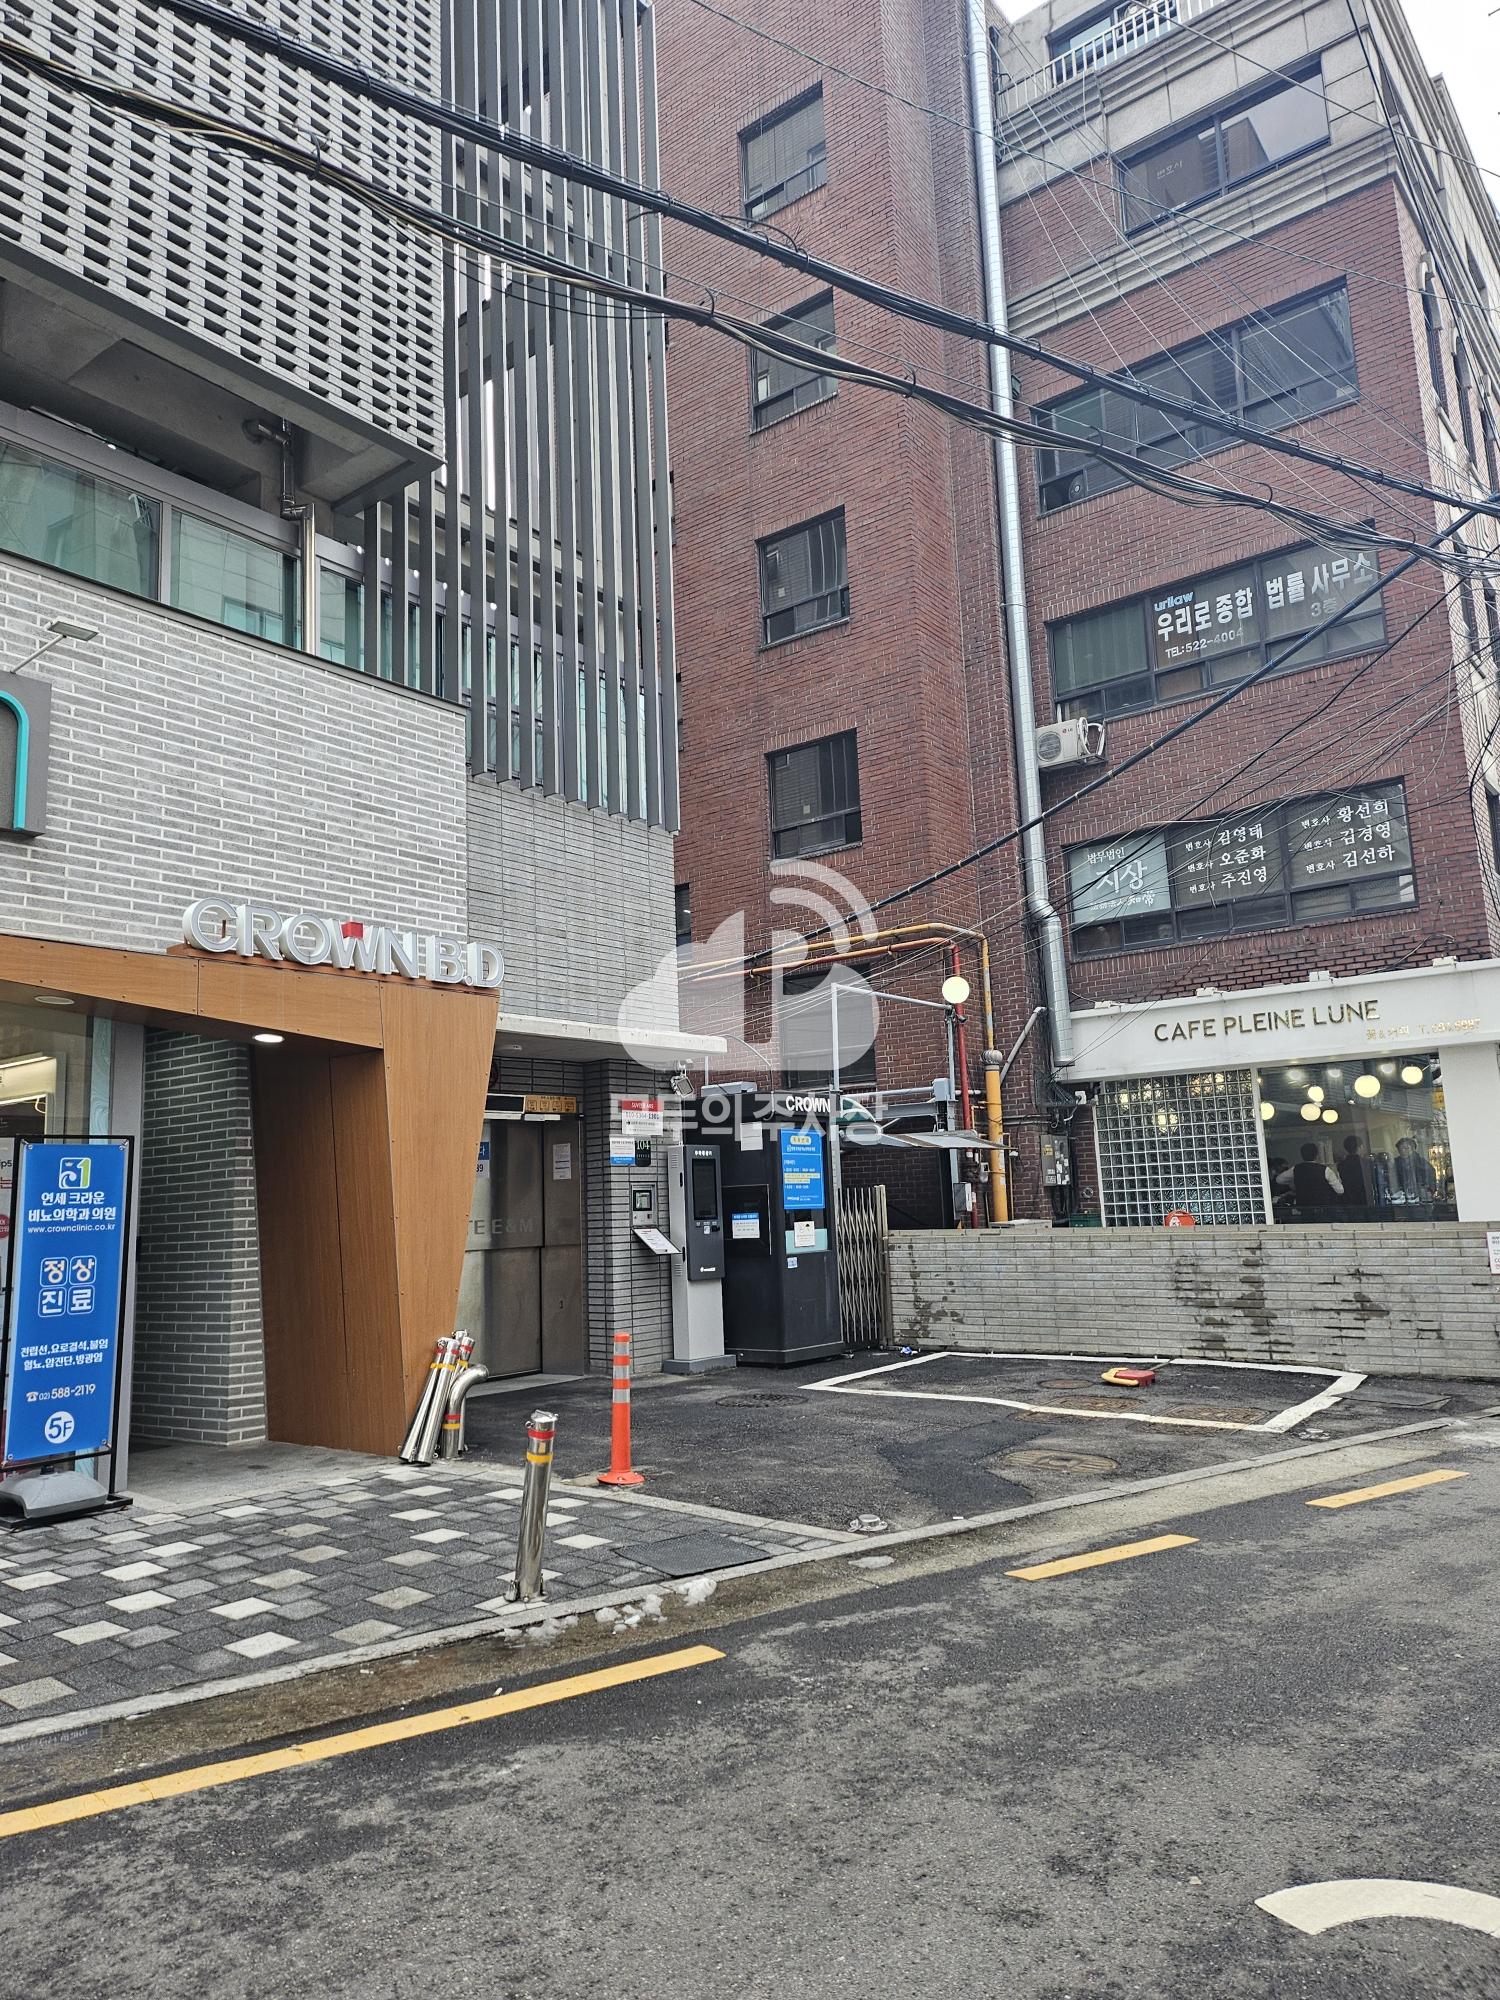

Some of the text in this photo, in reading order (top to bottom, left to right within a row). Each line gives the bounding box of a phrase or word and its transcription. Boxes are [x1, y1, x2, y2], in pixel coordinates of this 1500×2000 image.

[1157, 552, 1373, 641] 우리로 종합 법률 사무소
[1301, 799, 1389, 829] 변호사 황선희
[1185, 823, 1263, 852] 변호사 김영태
[1340, 822, 1391, 845] 김경영
[1187, 845, 1266, 873] 변호사 오준화
[1306, 844, 1396, 874] 변호사 김선하
[1189, 866, 1267, 894] 변호사 주진영
[182, 897, 505, 988] CROWN B.D
[1153, 1000, 1380, 1042] CAFE PLEINE LUNE
[785, 1095, 831, 1114] CROWN
[41, 1191, 105, 1206] 연세 크라운
[27, 1223, 116, 1234] www.crownclinic.co.kr
[28, 1207, 117, 1223] 비뇨의학과 의원
[43, 1258, 95, 1284] 정상
[41, 1288, 92, 1314] 진료
[48, 1417, 73, 1439] 5F
